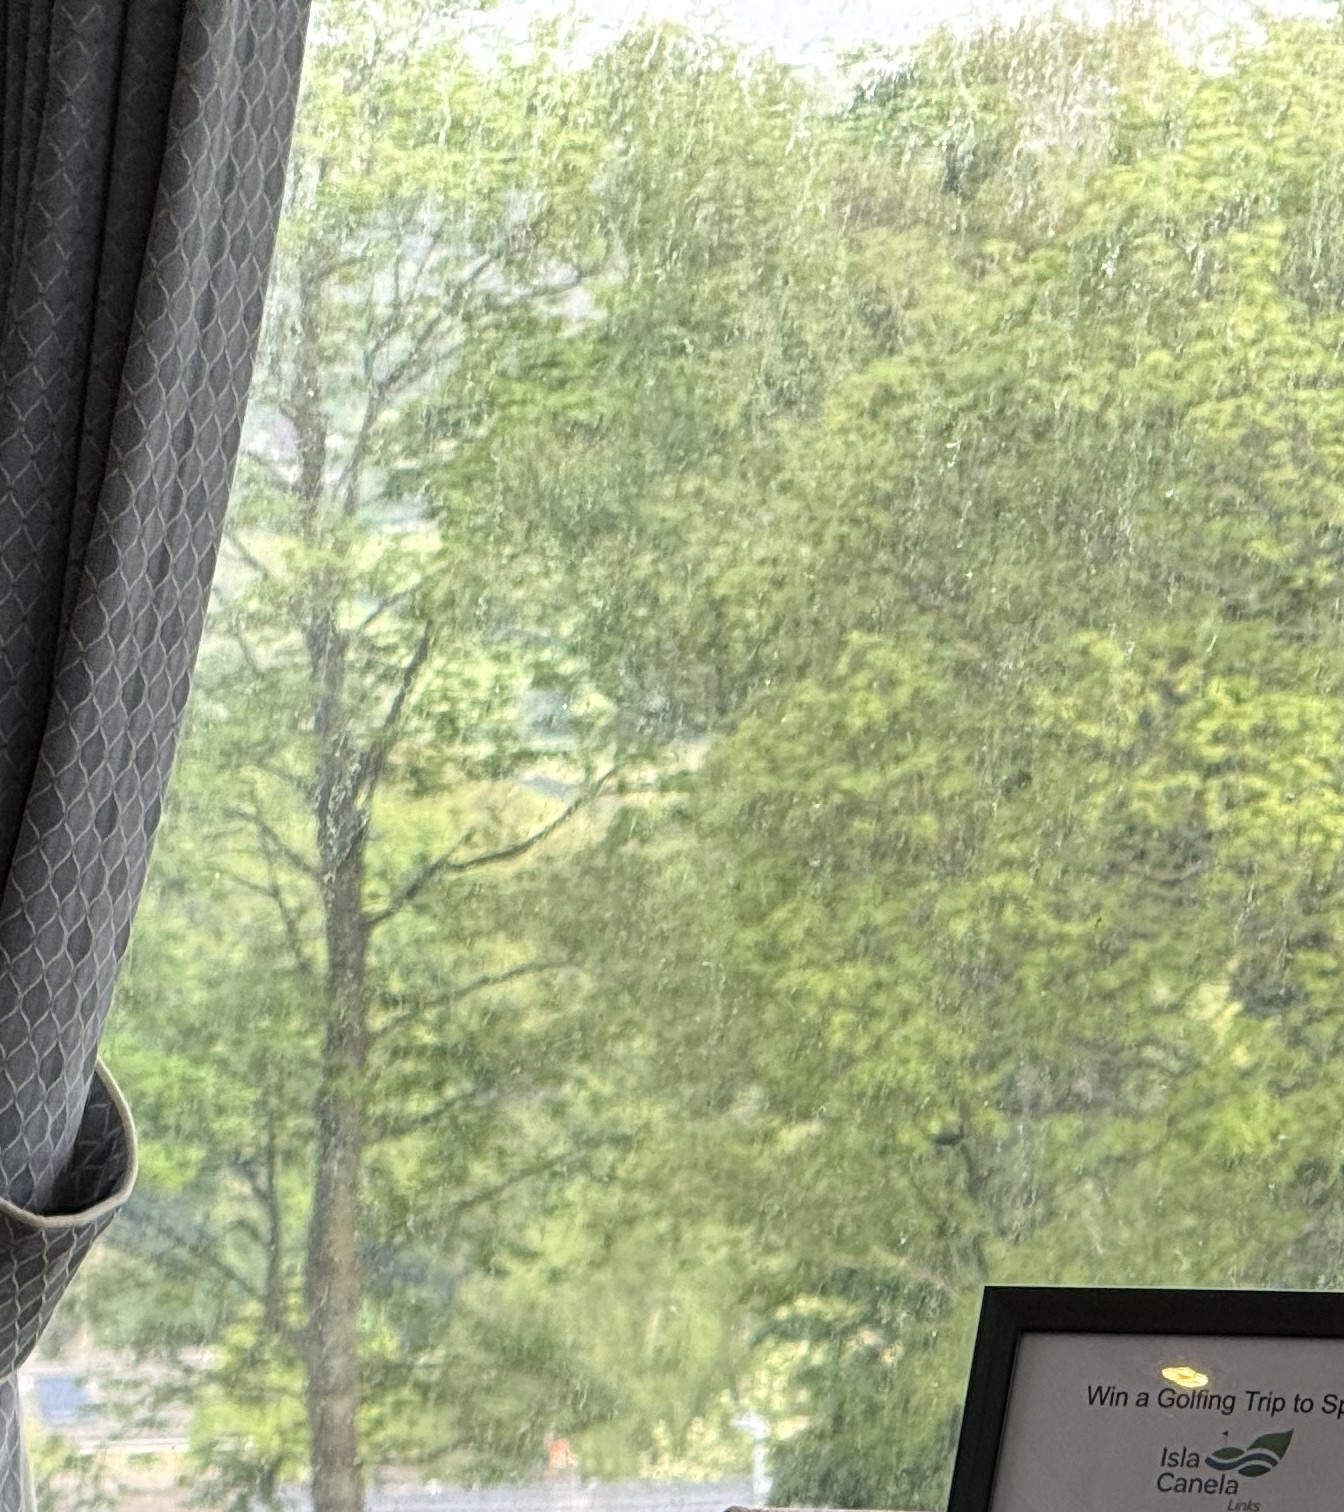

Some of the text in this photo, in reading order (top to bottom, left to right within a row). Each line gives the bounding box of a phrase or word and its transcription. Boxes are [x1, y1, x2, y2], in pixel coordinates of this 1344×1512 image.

[1087, 1385, 1127, 1407] Win
[1136, 1392, 1149, 1408] a
[1157, 1387, 1236, 1415] Golfing
[1245, 1390, 1286, 1417] Trip
[1293, 1396, 1313, 1414] to
[1160, 1447, 1200, 1468] Isla
[1157, 1472, 1239, 1495] Canela
[1227, 1499, 1261, 1512] Links
